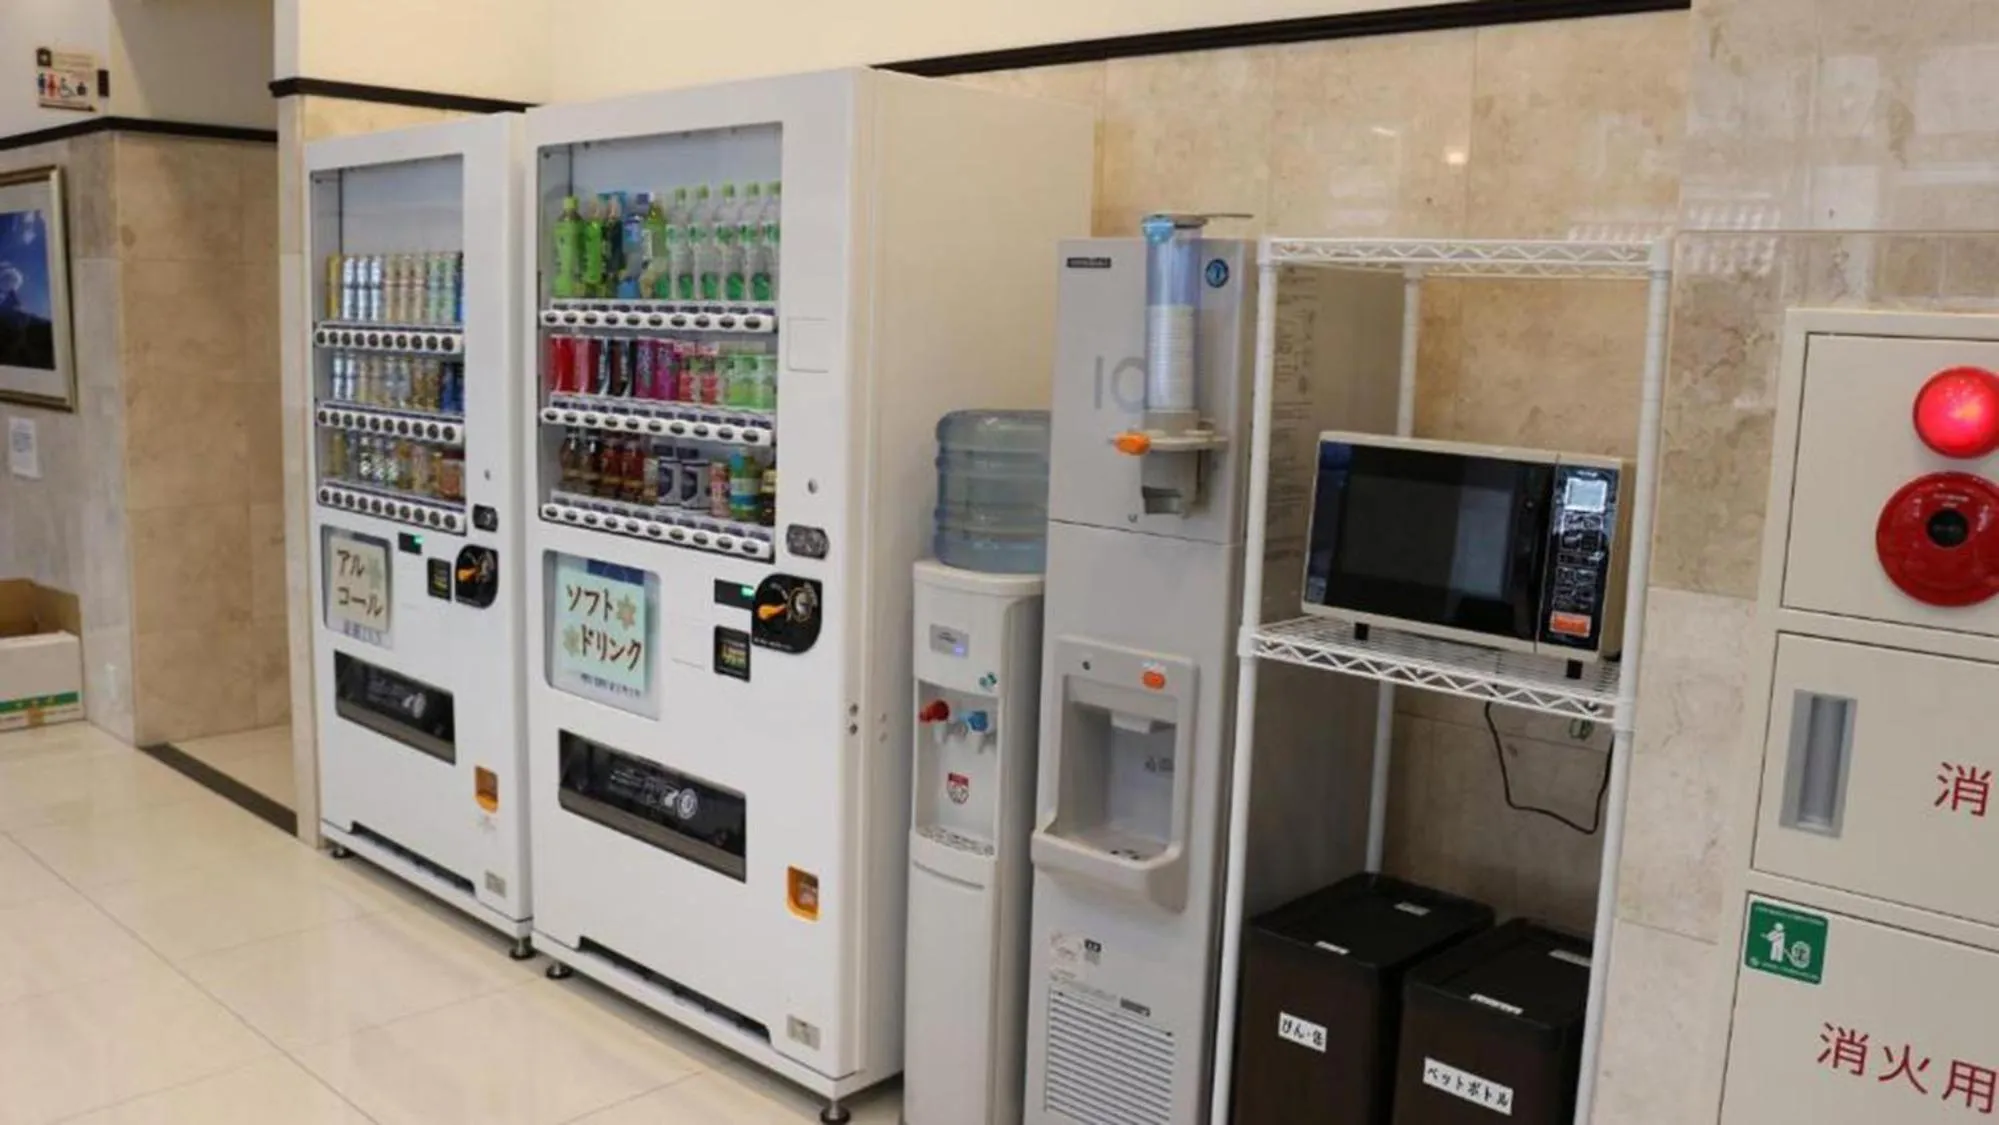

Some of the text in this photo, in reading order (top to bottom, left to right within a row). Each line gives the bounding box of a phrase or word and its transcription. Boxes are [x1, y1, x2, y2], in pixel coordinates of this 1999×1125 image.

[337, 549, 365, 577] アル
[337, 586, 384, 617] コール
[566, 584, 613, 621] ソフト
[581, 624, 642, 670] ドリンク
[1934, 761, 1992, 817] 消
[1427, 1066, 1509, 1107] ペットボトル
[1816, 1021, 1997, 1114] 消火用
